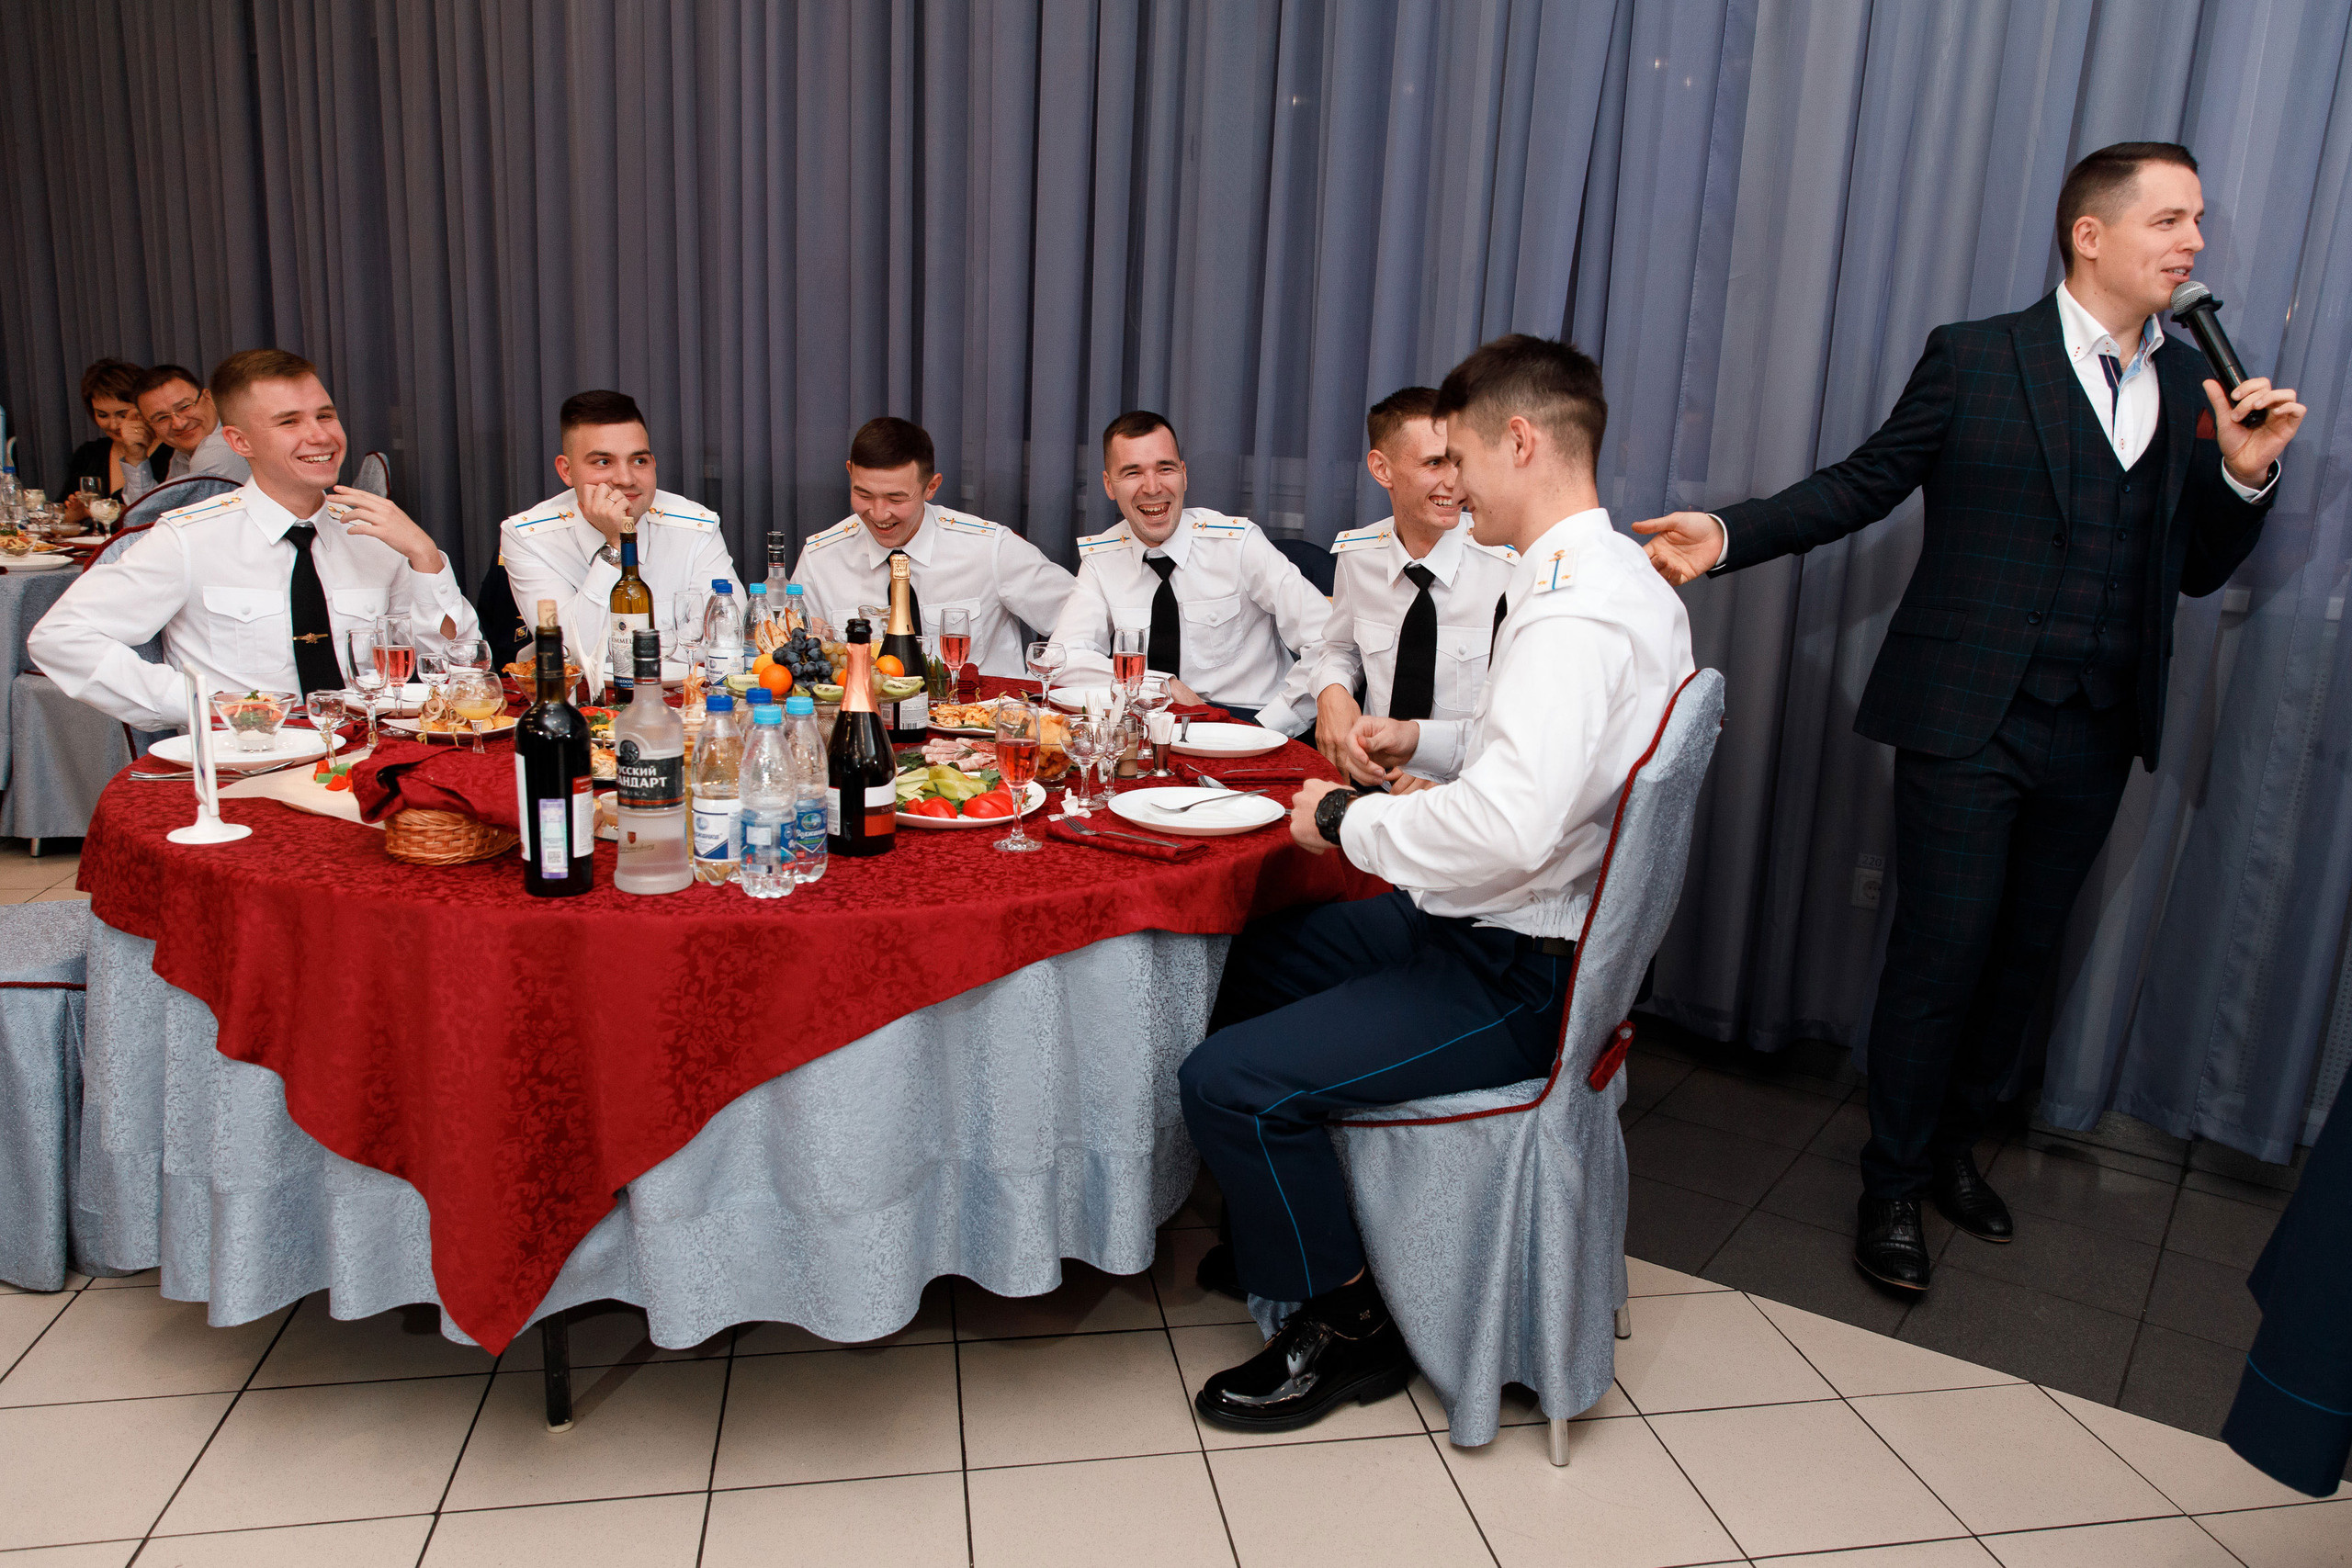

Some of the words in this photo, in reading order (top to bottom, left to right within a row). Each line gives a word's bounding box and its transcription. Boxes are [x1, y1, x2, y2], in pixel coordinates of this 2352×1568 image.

[616, 764, 657, 776] УССКИЙ
[617, 775, 668, 788] АНДАРТ
[1861, 854, 1883, 867] 220
